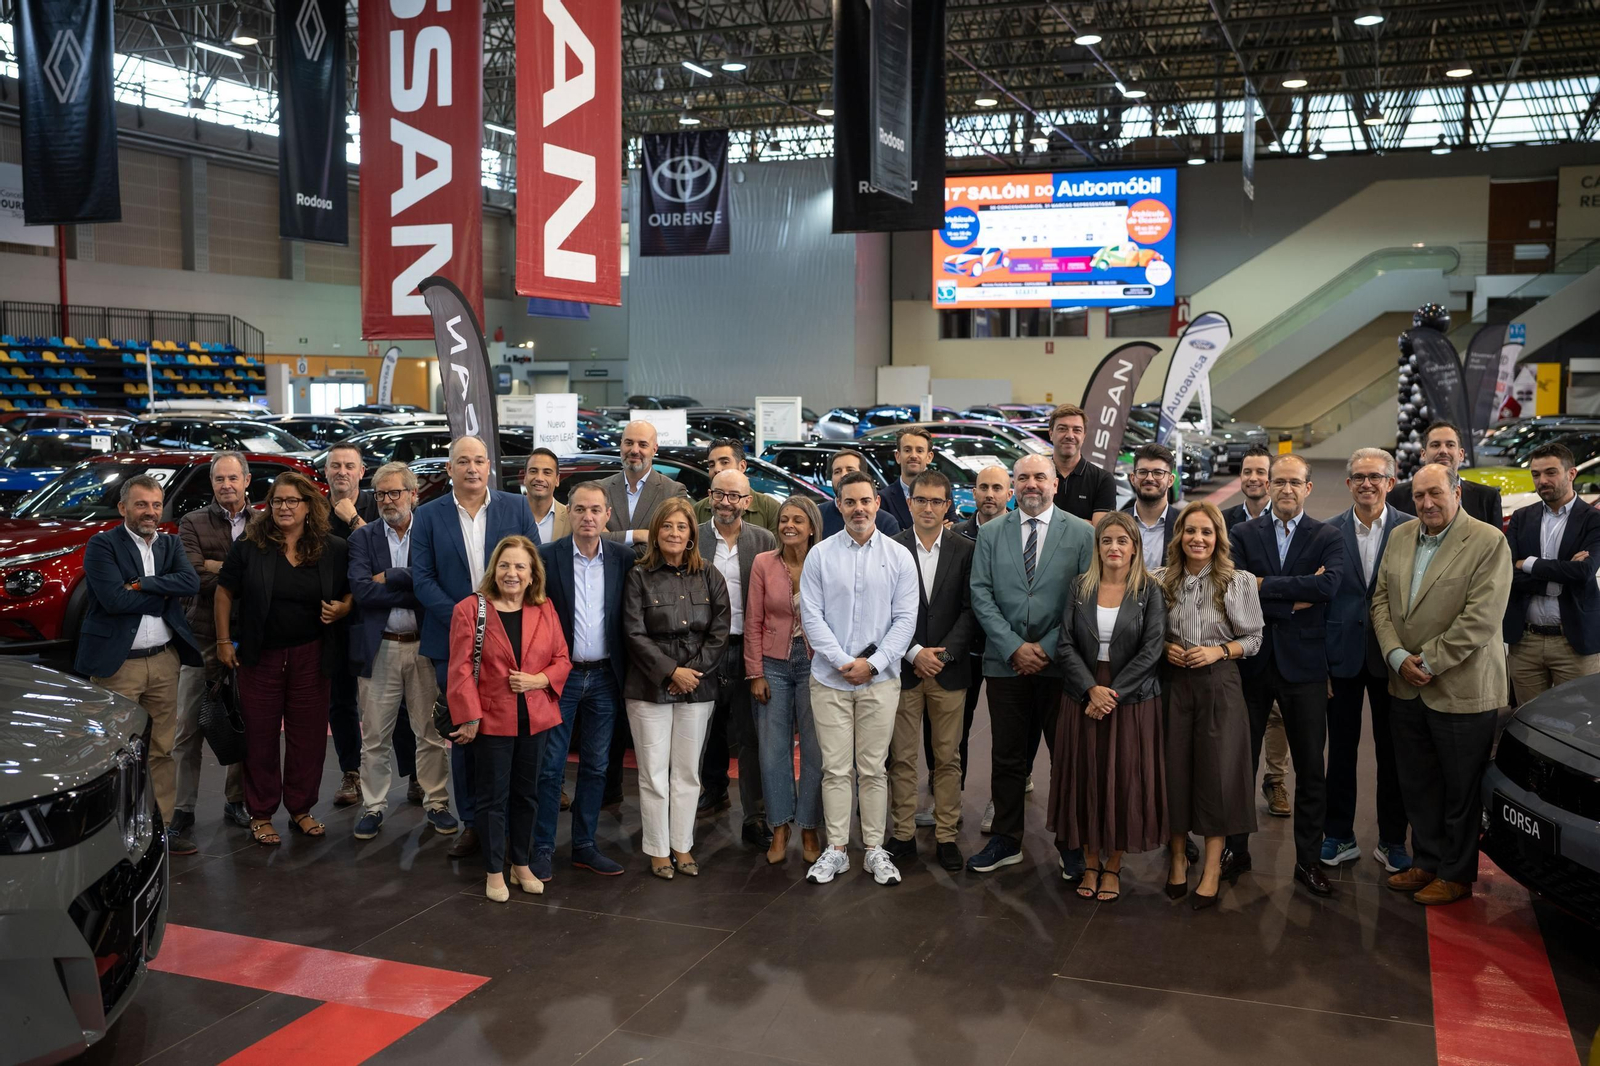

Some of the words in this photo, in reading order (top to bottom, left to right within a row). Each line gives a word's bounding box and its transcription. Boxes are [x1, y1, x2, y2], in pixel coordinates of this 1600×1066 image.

[879, 127, 905, 152] Rodosa
[390, 0, 453, 316] SAN
[967, 182, 1030, 201] SALÓN
[1034, 185, 1055, 197] DO
[1056, 176, 1162, 198] Automóbil
[296, 192, 333, 210] Rodosa
[648, 211, 723, 228] OURENSE
[1167, 354, 1208, 416] Autoavisa
[547, 420, 567, 429] Nuevo
[539, 433, 559, 443] Nissan
[559, 432, 575, 442] LEAF
[475, 624, 485, 647] LOLA
[1503, 804, 1540, 839] CORSA
